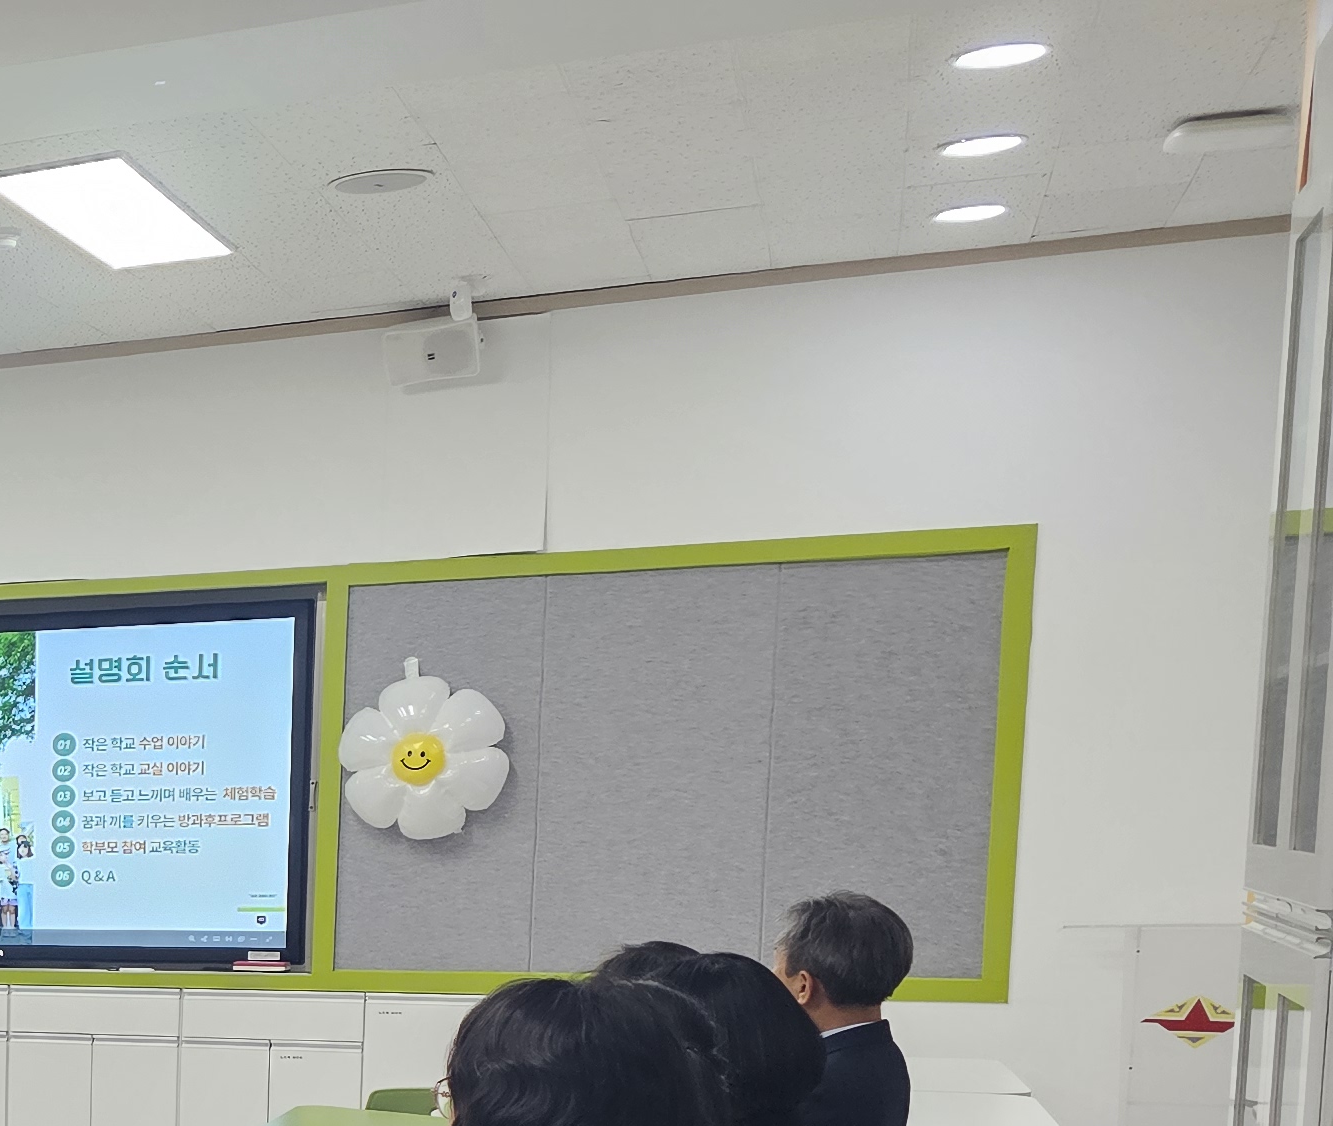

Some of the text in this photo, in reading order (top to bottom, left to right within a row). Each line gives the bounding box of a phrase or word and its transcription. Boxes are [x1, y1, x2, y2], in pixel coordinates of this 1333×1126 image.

[69, 652, 219, 685] 설명회 순서
[82, 737, 108, 752] 작은
[110, 736, 136, 751] 학교
[138, 735, 164, 750] 수업
[167, 734, 206, 750] 이야기
[82, 763, 108, 777] 작은
[110, 763, 135, 777] 학교
[138, 761, 163, 776] 교실
[166, 760, 205, 775] 이야기
[83, 789, 107, 802] 보고
[110, 788, 135, 803] 듣고
[138, 787, 175, 802] 느끼며
[179, 786, 218, 801] 배우는
[222, 785, 277, 801] 체험학습
[82, 815, 107, 829] 꿈과
[109, 814, 134, 829] 끼를
[137, 813, 175, 828] 키우는
[178, 812, 270, 828] 방과후프로그램
[82, 841, 119, 855] 학부모
[121, 840, 147, 855] 참여
[149, 839, 201, 855] 교육활동
